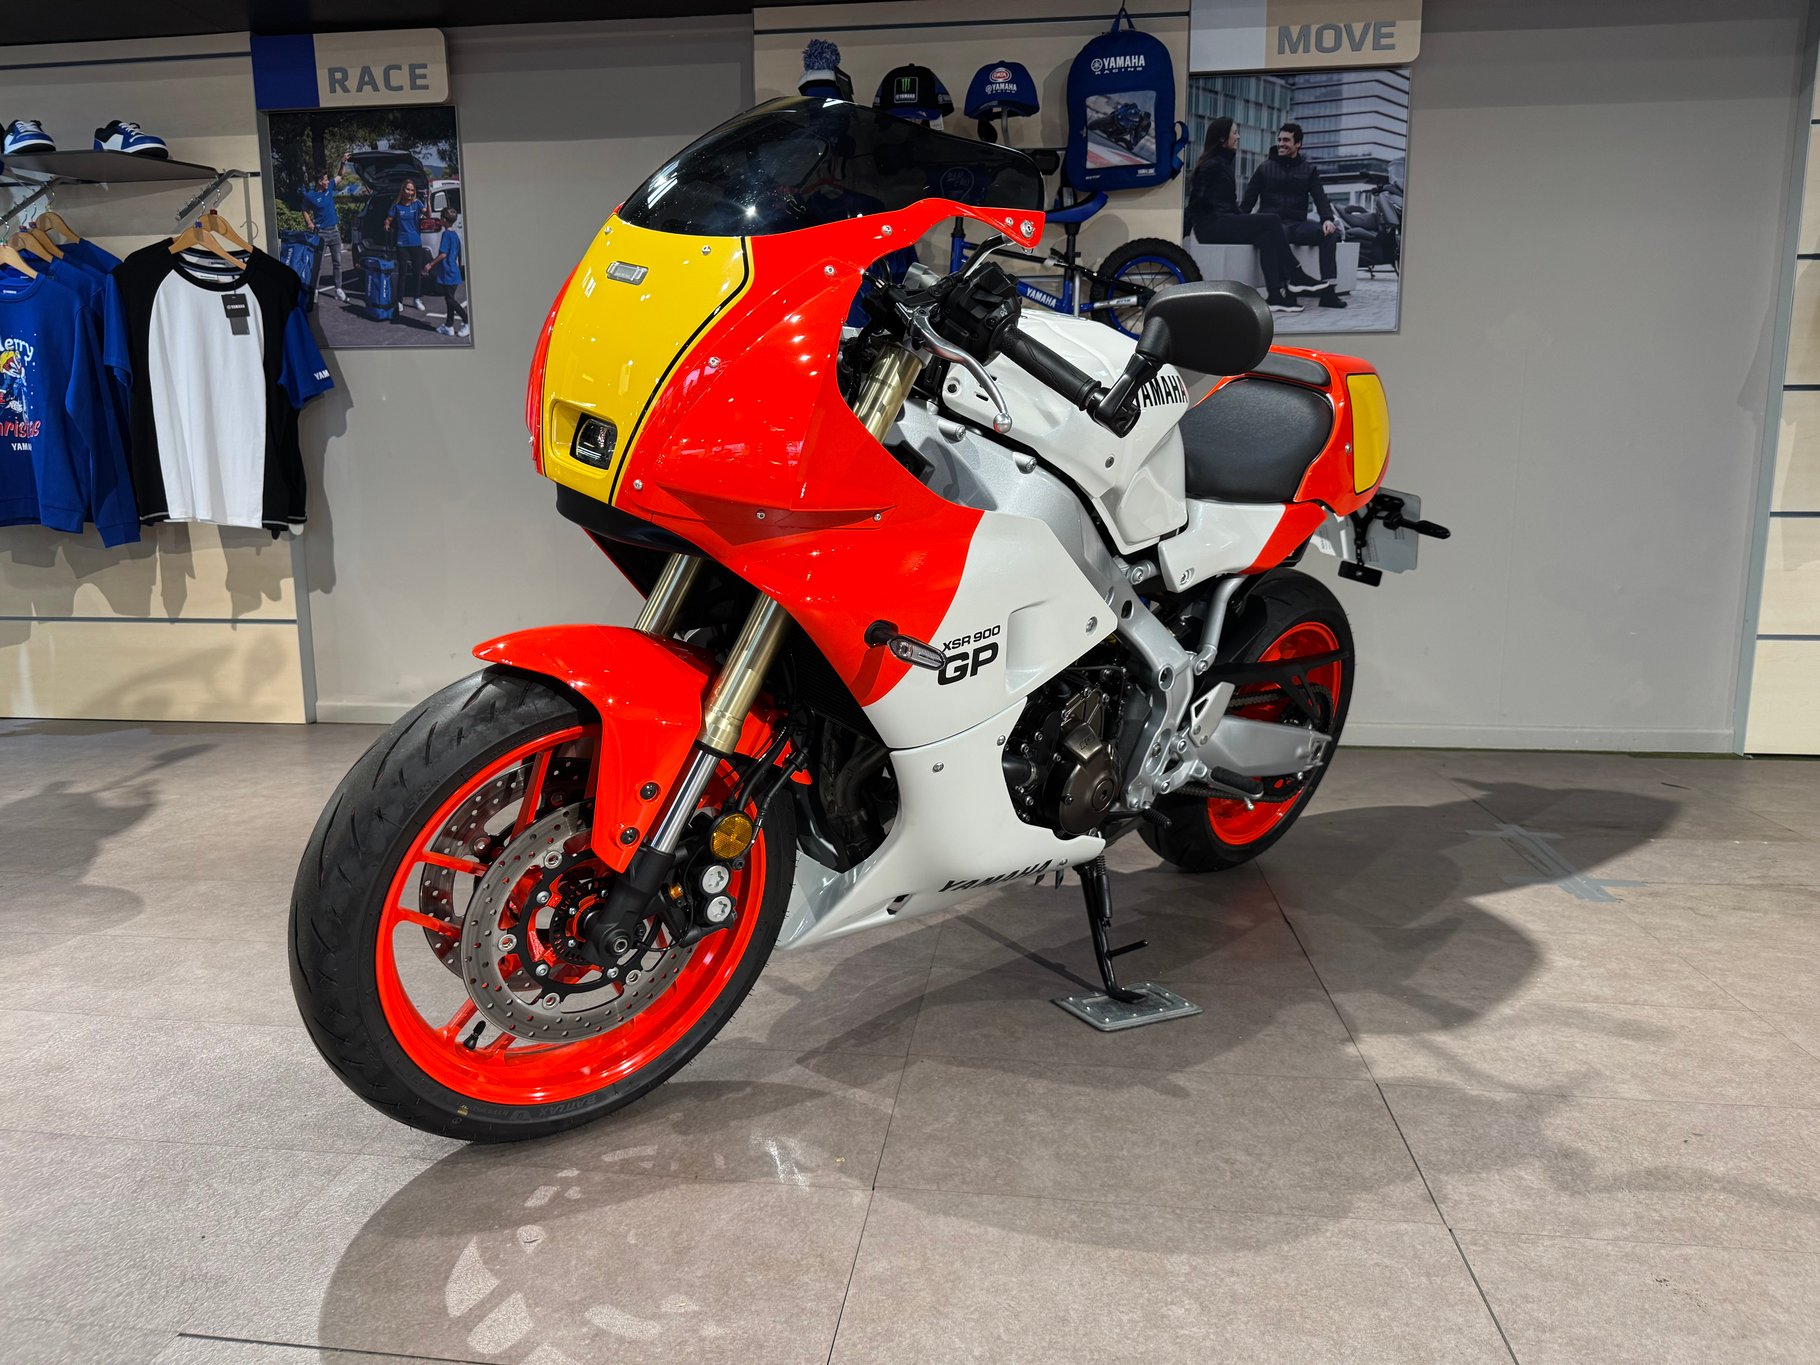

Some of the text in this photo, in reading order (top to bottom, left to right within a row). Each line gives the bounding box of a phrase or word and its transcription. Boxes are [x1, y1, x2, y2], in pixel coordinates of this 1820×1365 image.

[1277, 21, 1396, 55] MOVE
[1095, 67, 1143, 75] RACING
[1103, 55, 1146, 69] YAMAHA
[327, 63, 430, 94] RACE
[992, 83, 1017, 91] YAMAHA
[1026, 287, 1058, 308] YAMAHA
[1139, 375, 1189, 408] AMAHA
[942, 625, 1001, 653] XSR 900
[937, 641, 999, 686] GP
[937, 858, 1054, 893] YAMAHA
